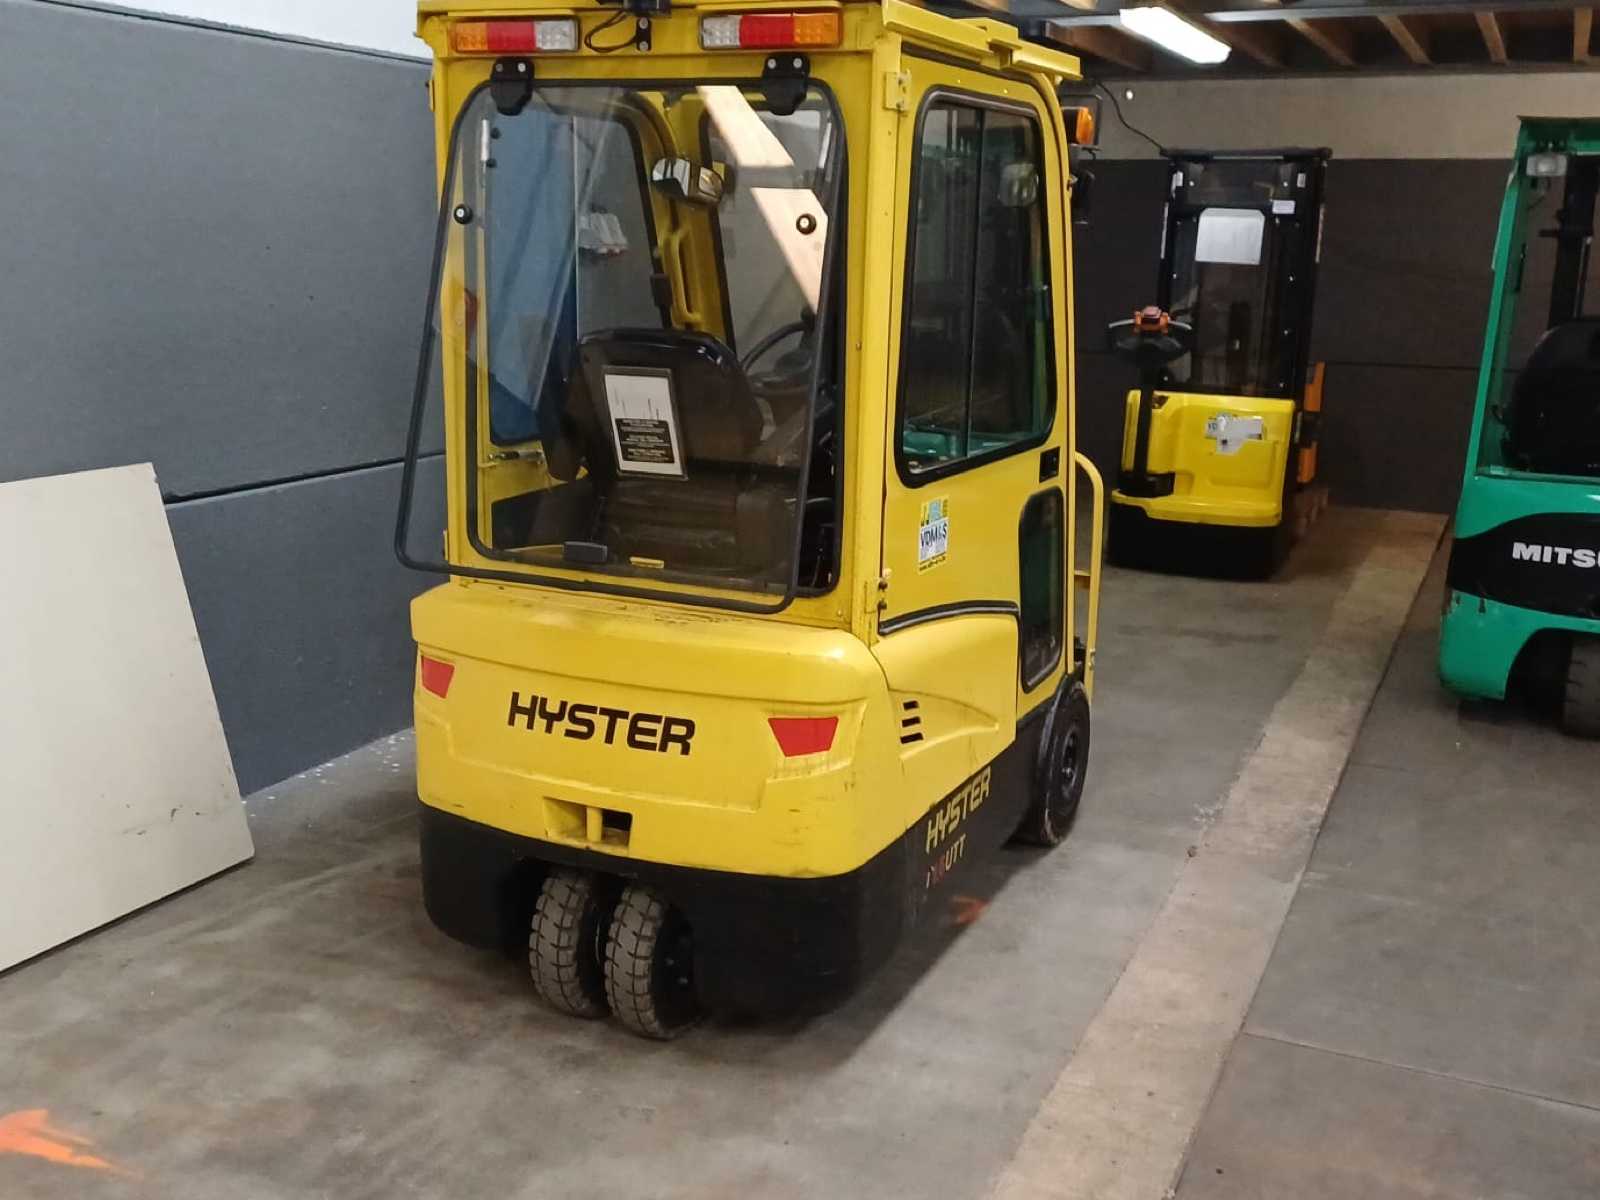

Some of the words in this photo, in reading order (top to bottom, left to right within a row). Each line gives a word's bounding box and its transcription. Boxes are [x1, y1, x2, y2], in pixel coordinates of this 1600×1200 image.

[1512, 541, 1600, 568] MITS
[508, 691, 696, 756] HYSTER
[926, 765, 991, 854] HYSTER
